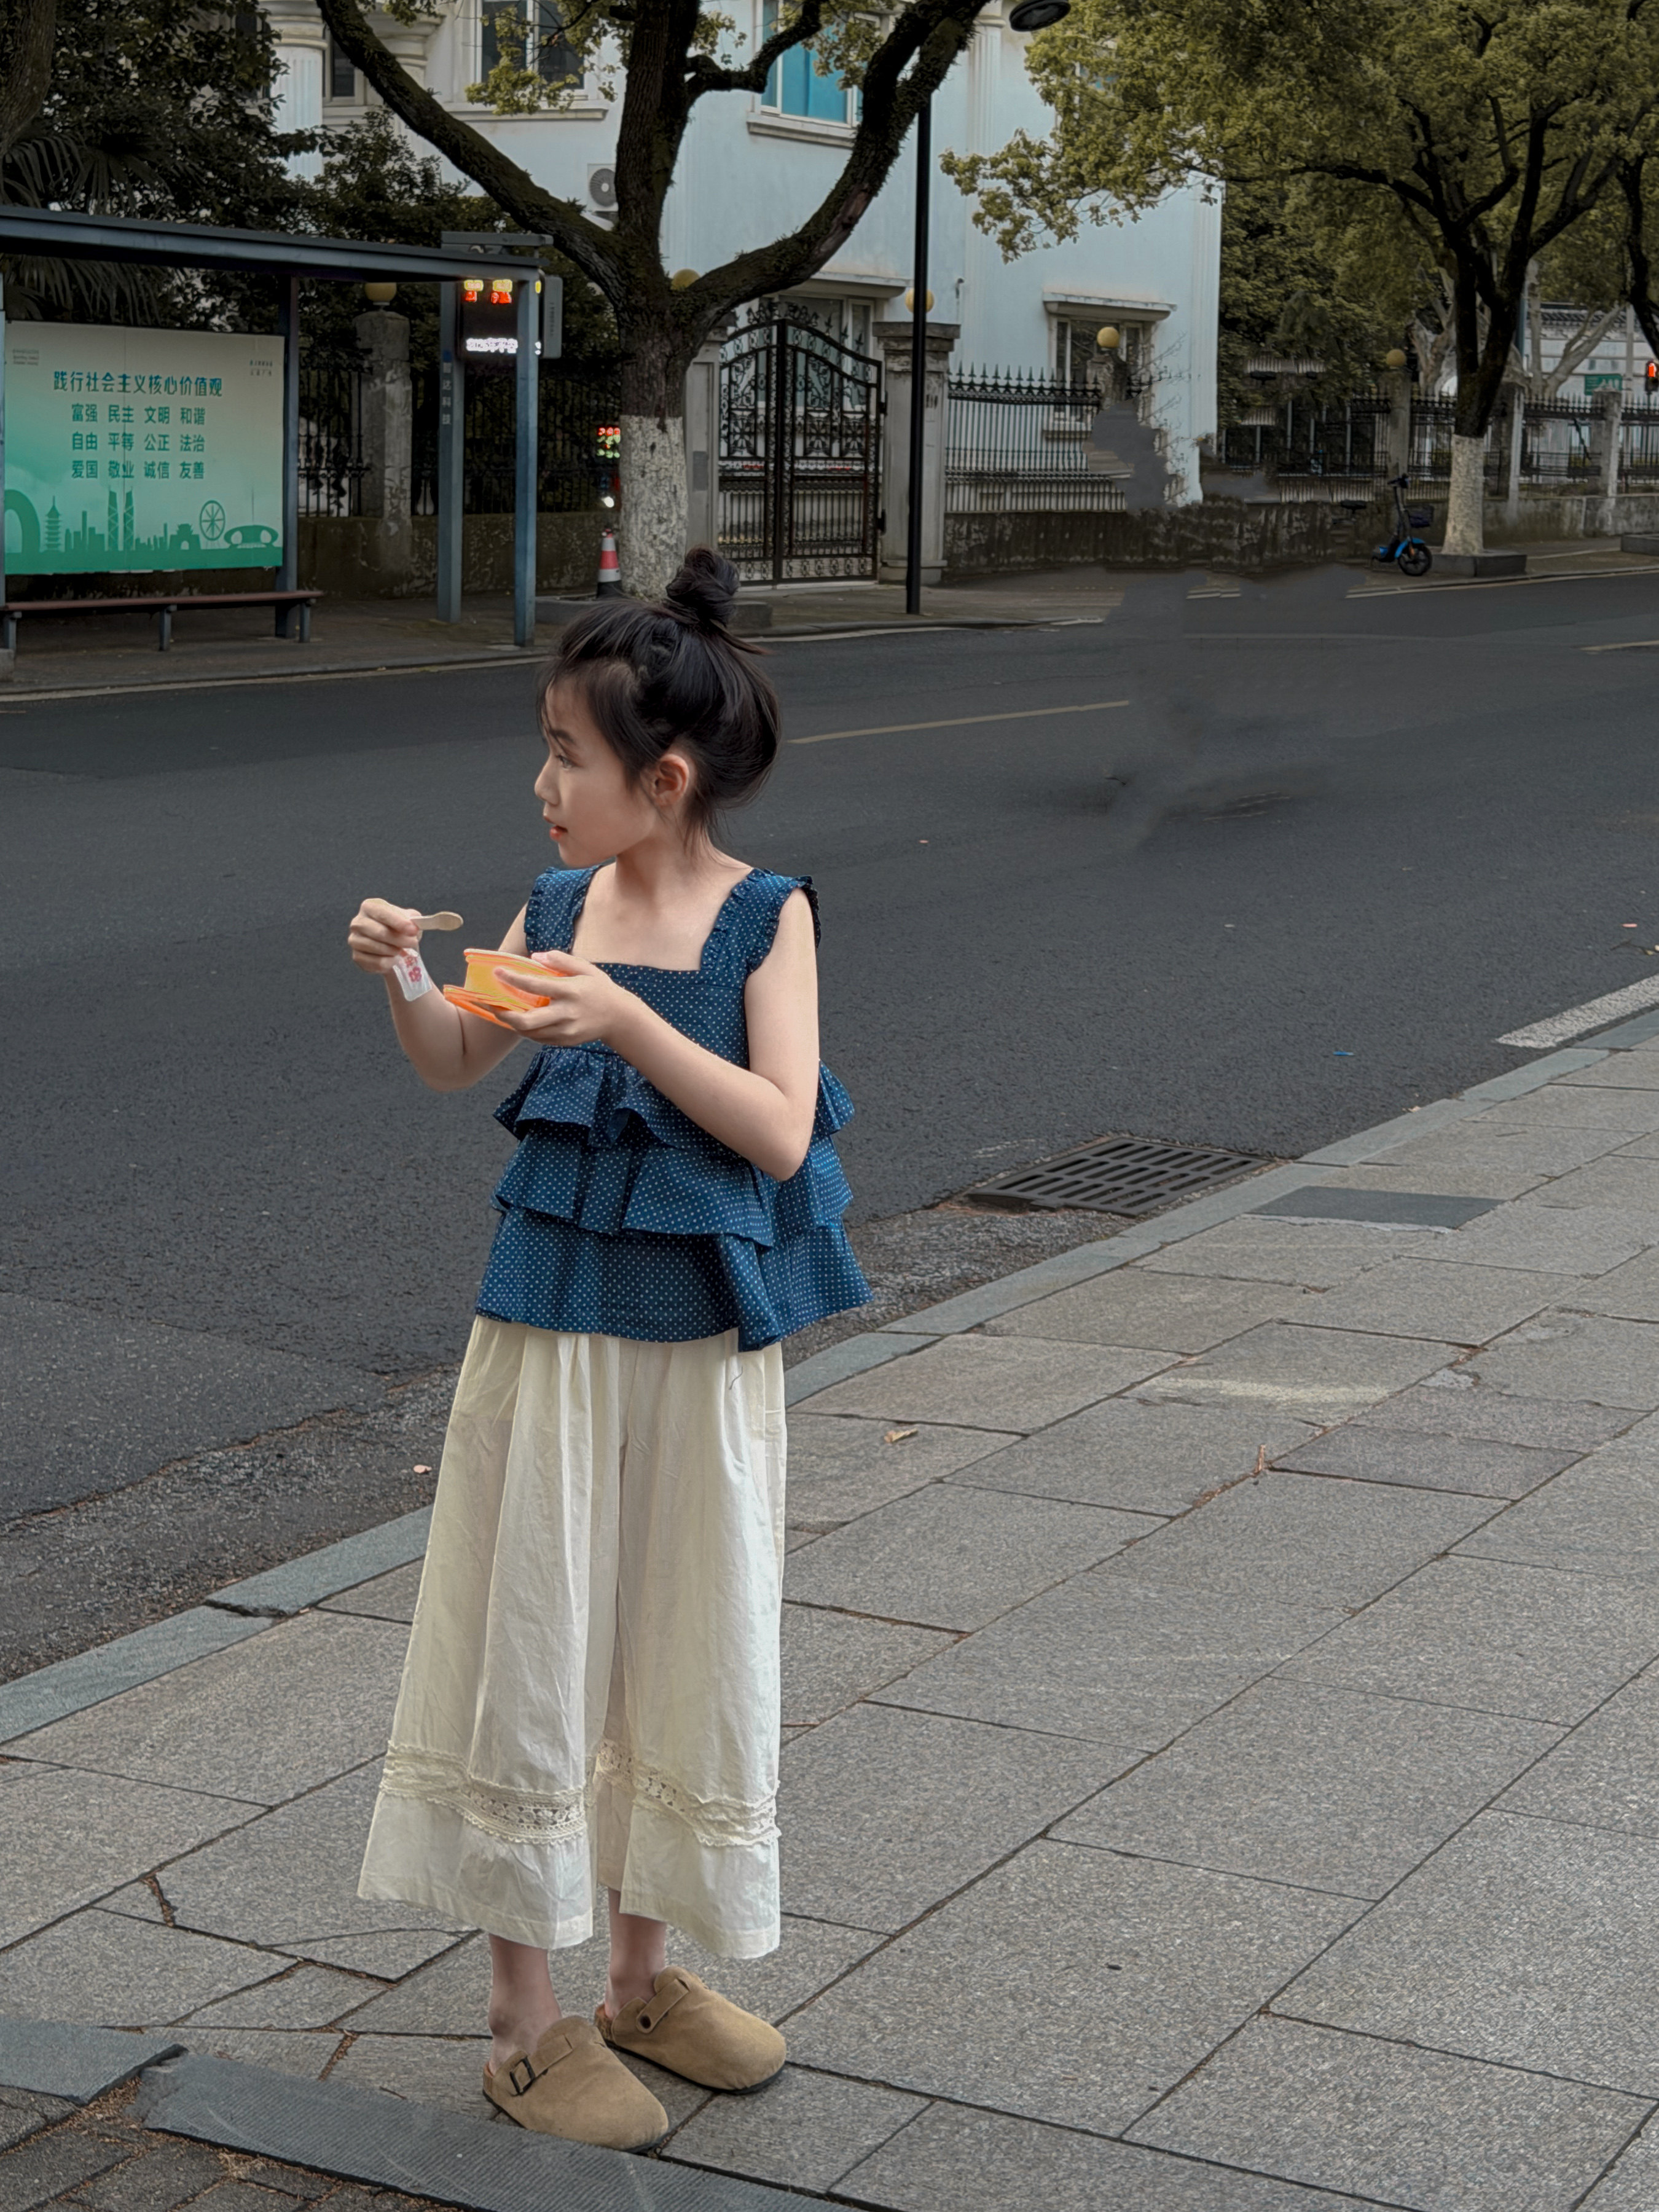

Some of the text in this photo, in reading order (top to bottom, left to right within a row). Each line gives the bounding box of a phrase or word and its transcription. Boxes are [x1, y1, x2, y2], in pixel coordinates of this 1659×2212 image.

[53, 371, 222, 397] 践行社会主义核心价值观
[71, 403, 206, 425] 富强 民主 文明 和谐
[71, 431, 205, 453] 自由 平等 公正 法治
[71, 460, 205, 479] 爱国 敬业 诚信 友善
